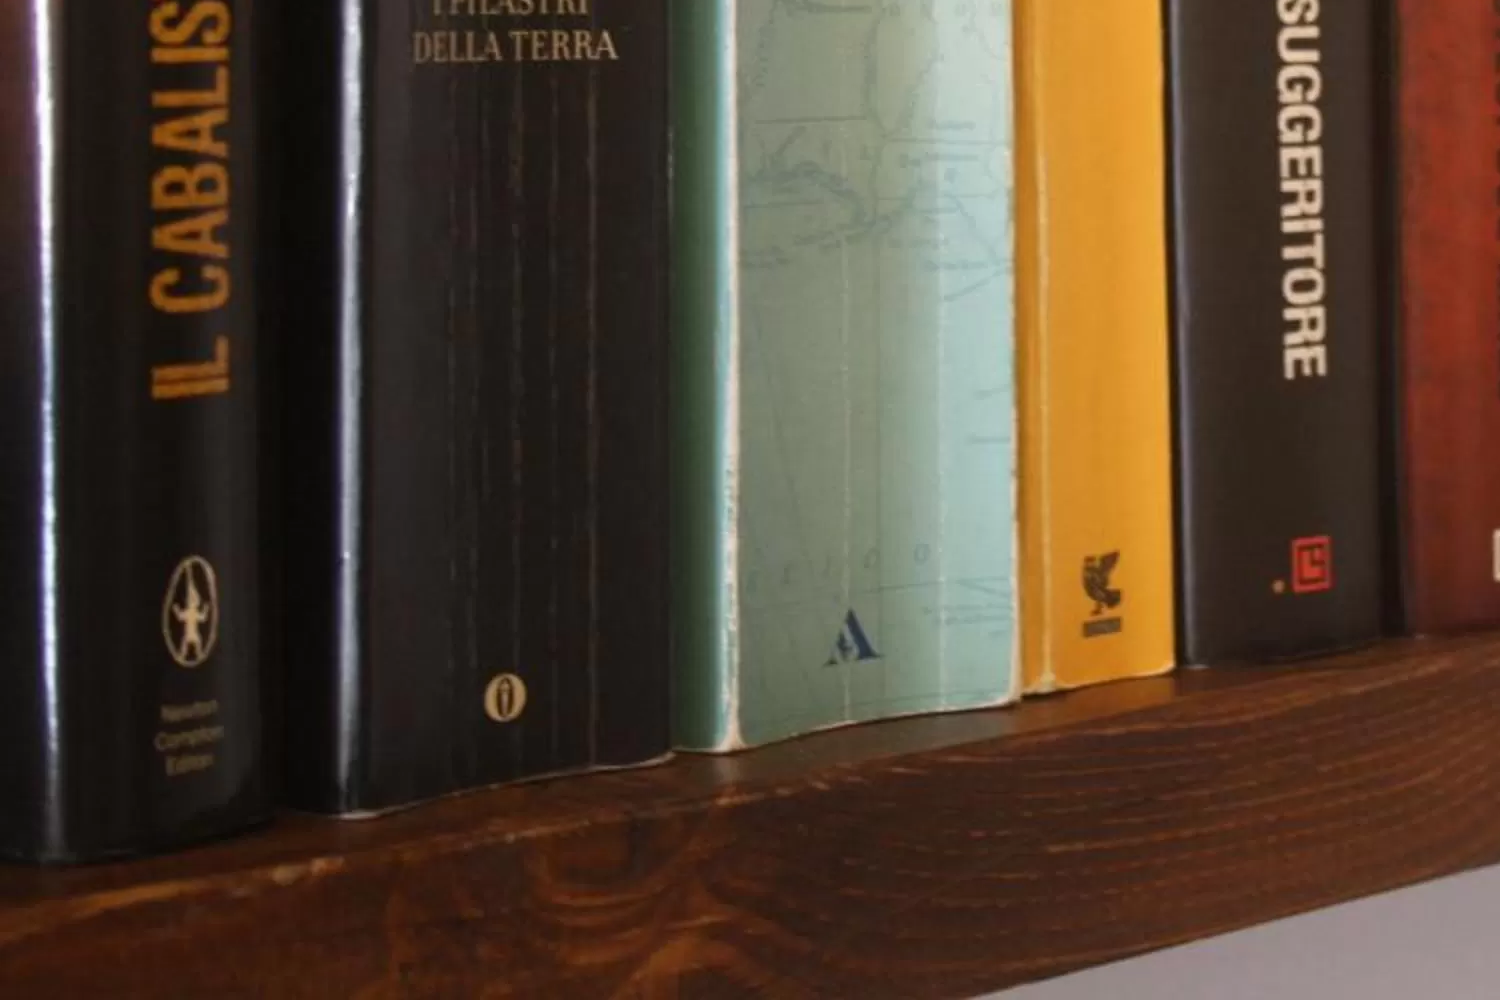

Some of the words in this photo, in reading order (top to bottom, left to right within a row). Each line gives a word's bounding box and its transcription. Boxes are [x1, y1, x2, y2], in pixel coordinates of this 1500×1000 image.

[413, 30, 503, 64] DELLA
[508, 28, 619, 62] TERRA
[151, 334, 230, 401] IL
